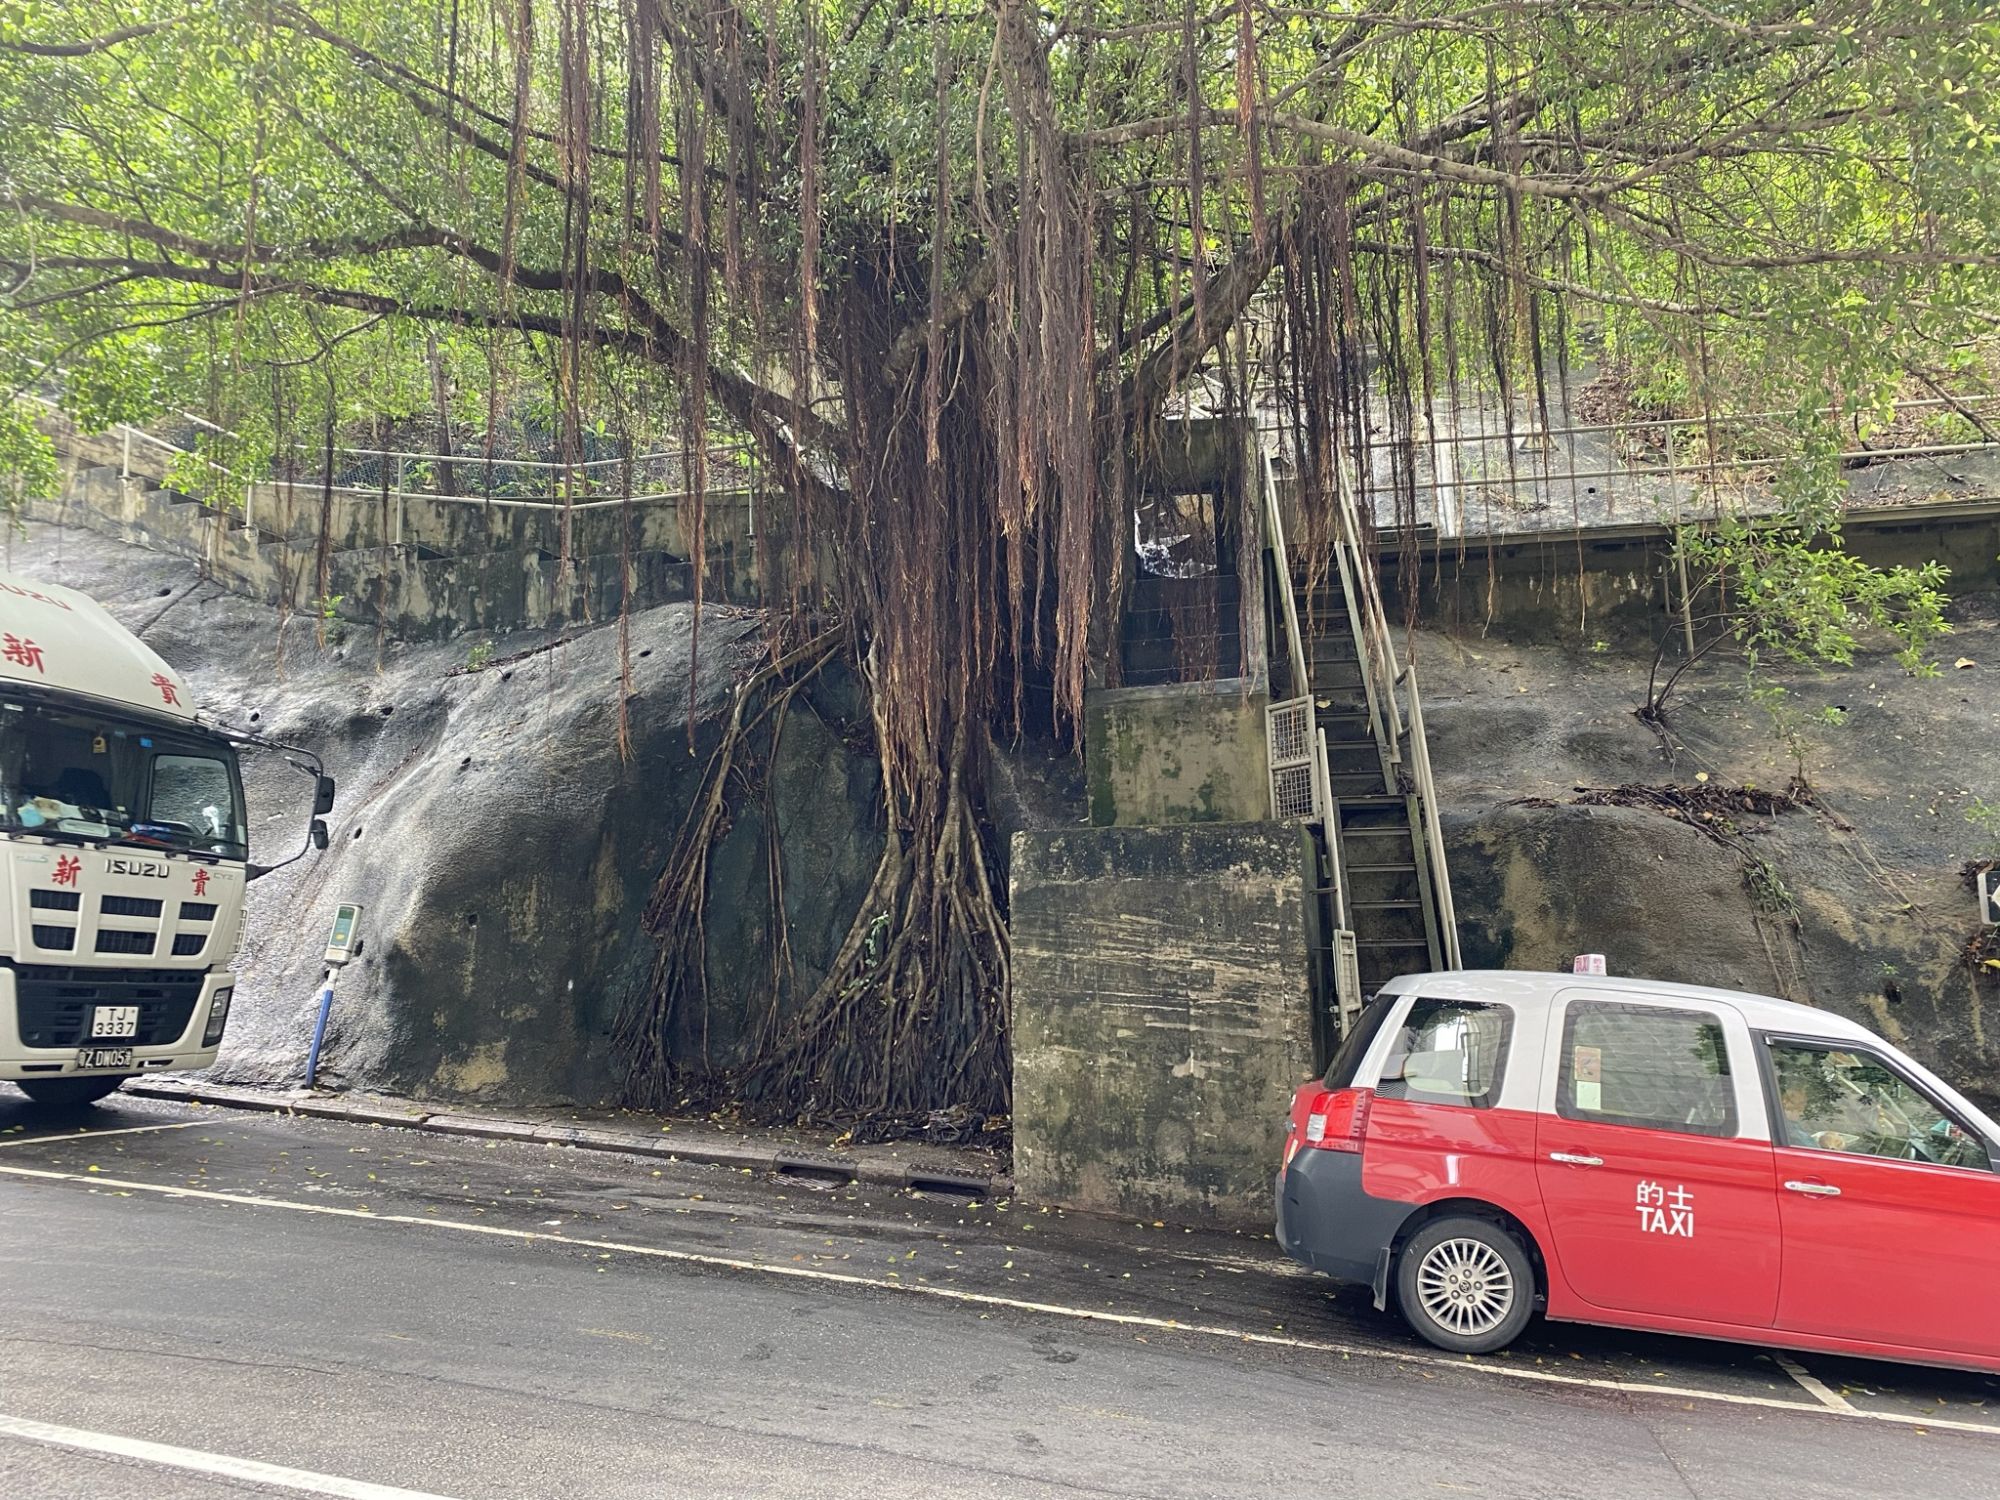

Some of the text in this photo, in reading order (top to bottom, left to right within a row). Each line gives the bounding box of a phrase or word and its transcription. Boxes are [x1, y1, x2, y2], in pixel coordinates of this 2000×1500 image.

[0, 582, 73, 611] UZU
[2, 632, 182, 709] 新 貴
[51, 854, 211, 897] 新 貴
[104, 859, 170, 879] ISUZU
[95, 1022, 135, 1035] 3337
[108, 1007, 127, 1021] TJ
[1636, 1180, 1694, 1211] 的士
[1635, 1205, 1695, 1238] TAXI
